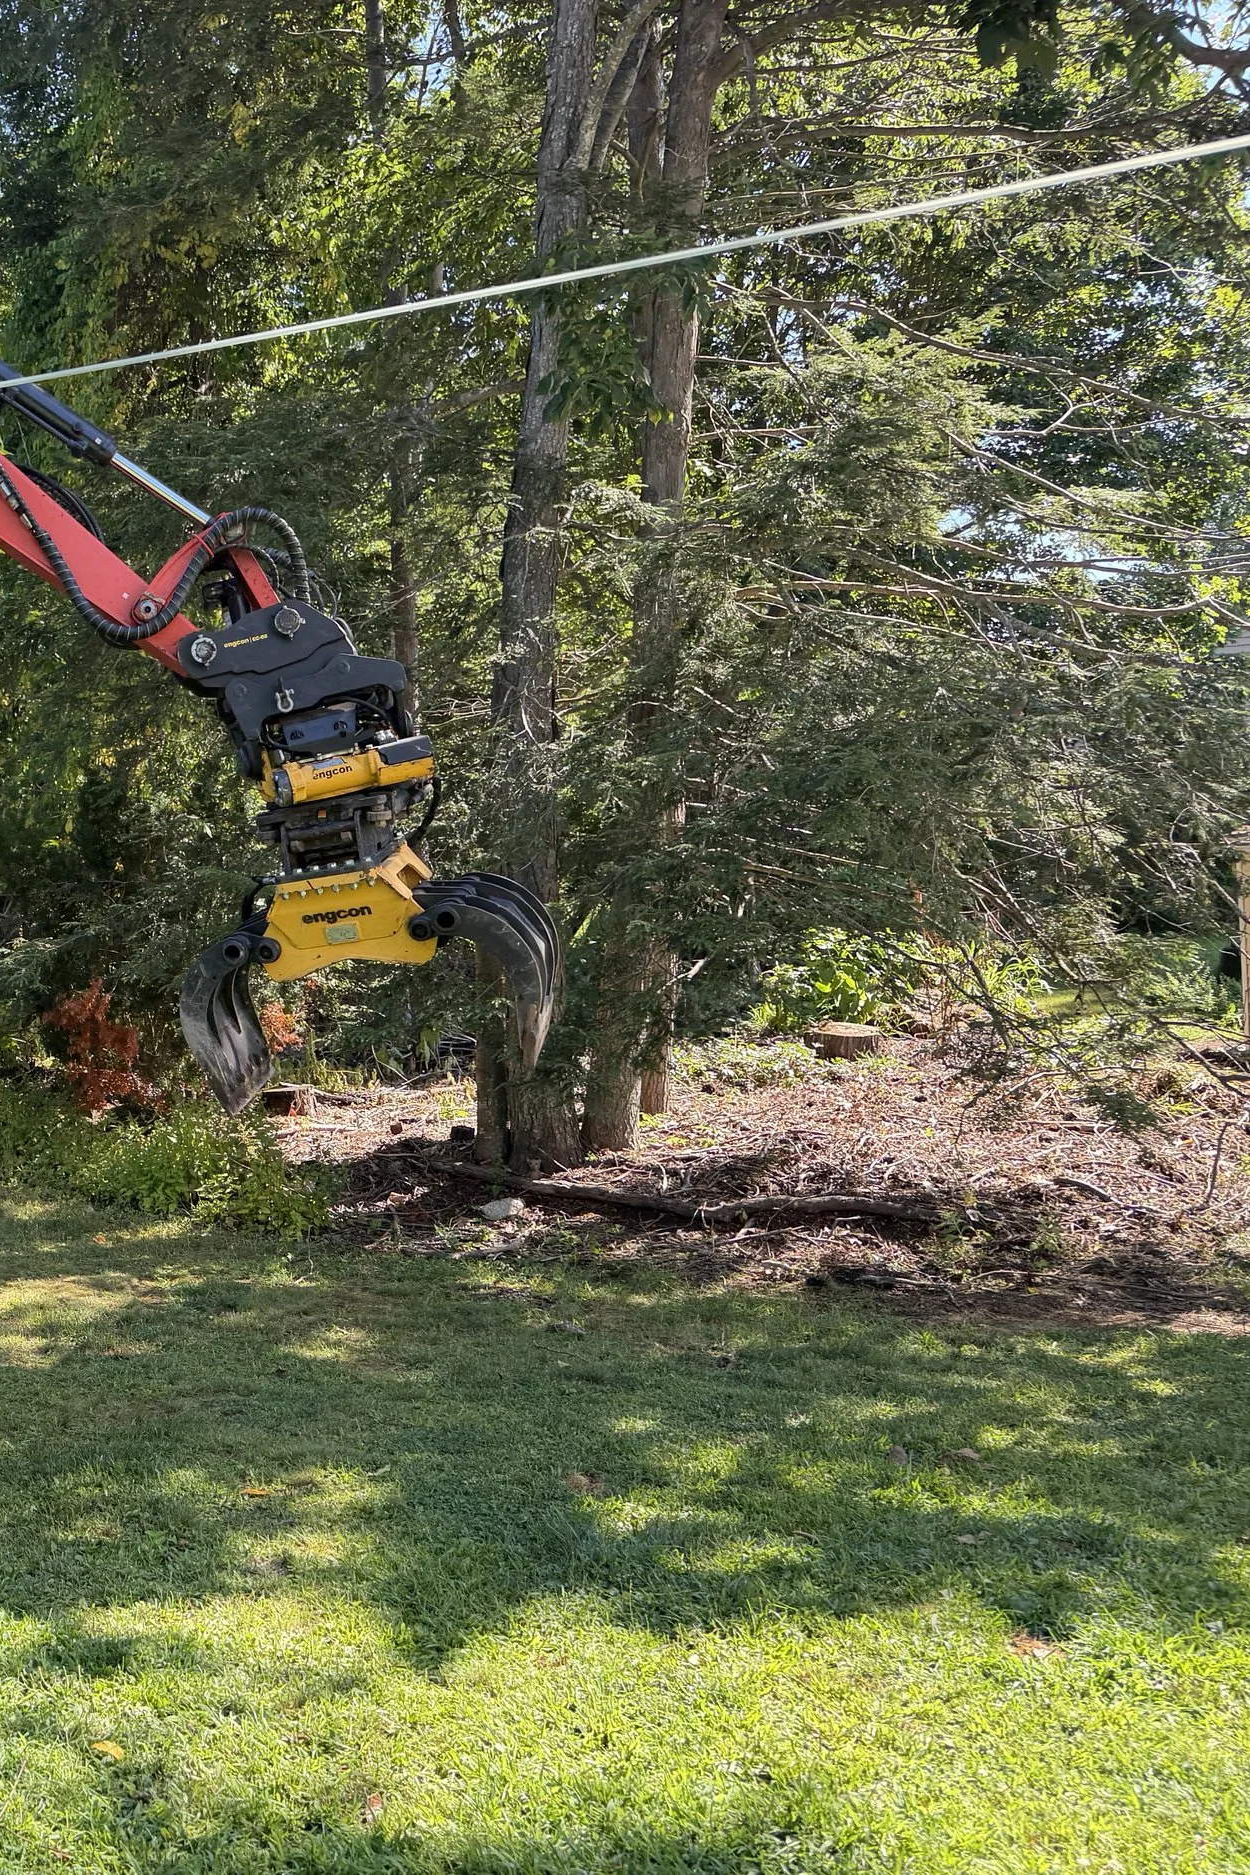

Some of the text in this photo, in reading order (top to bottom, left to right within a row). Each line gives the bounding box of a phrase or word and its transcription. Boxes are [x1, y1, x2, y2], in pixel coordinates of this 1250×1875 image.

[223, 638, 249, 648] engcon
[313, 765, 353, 780] engcon
[301, 904, 373, 925] engcon
